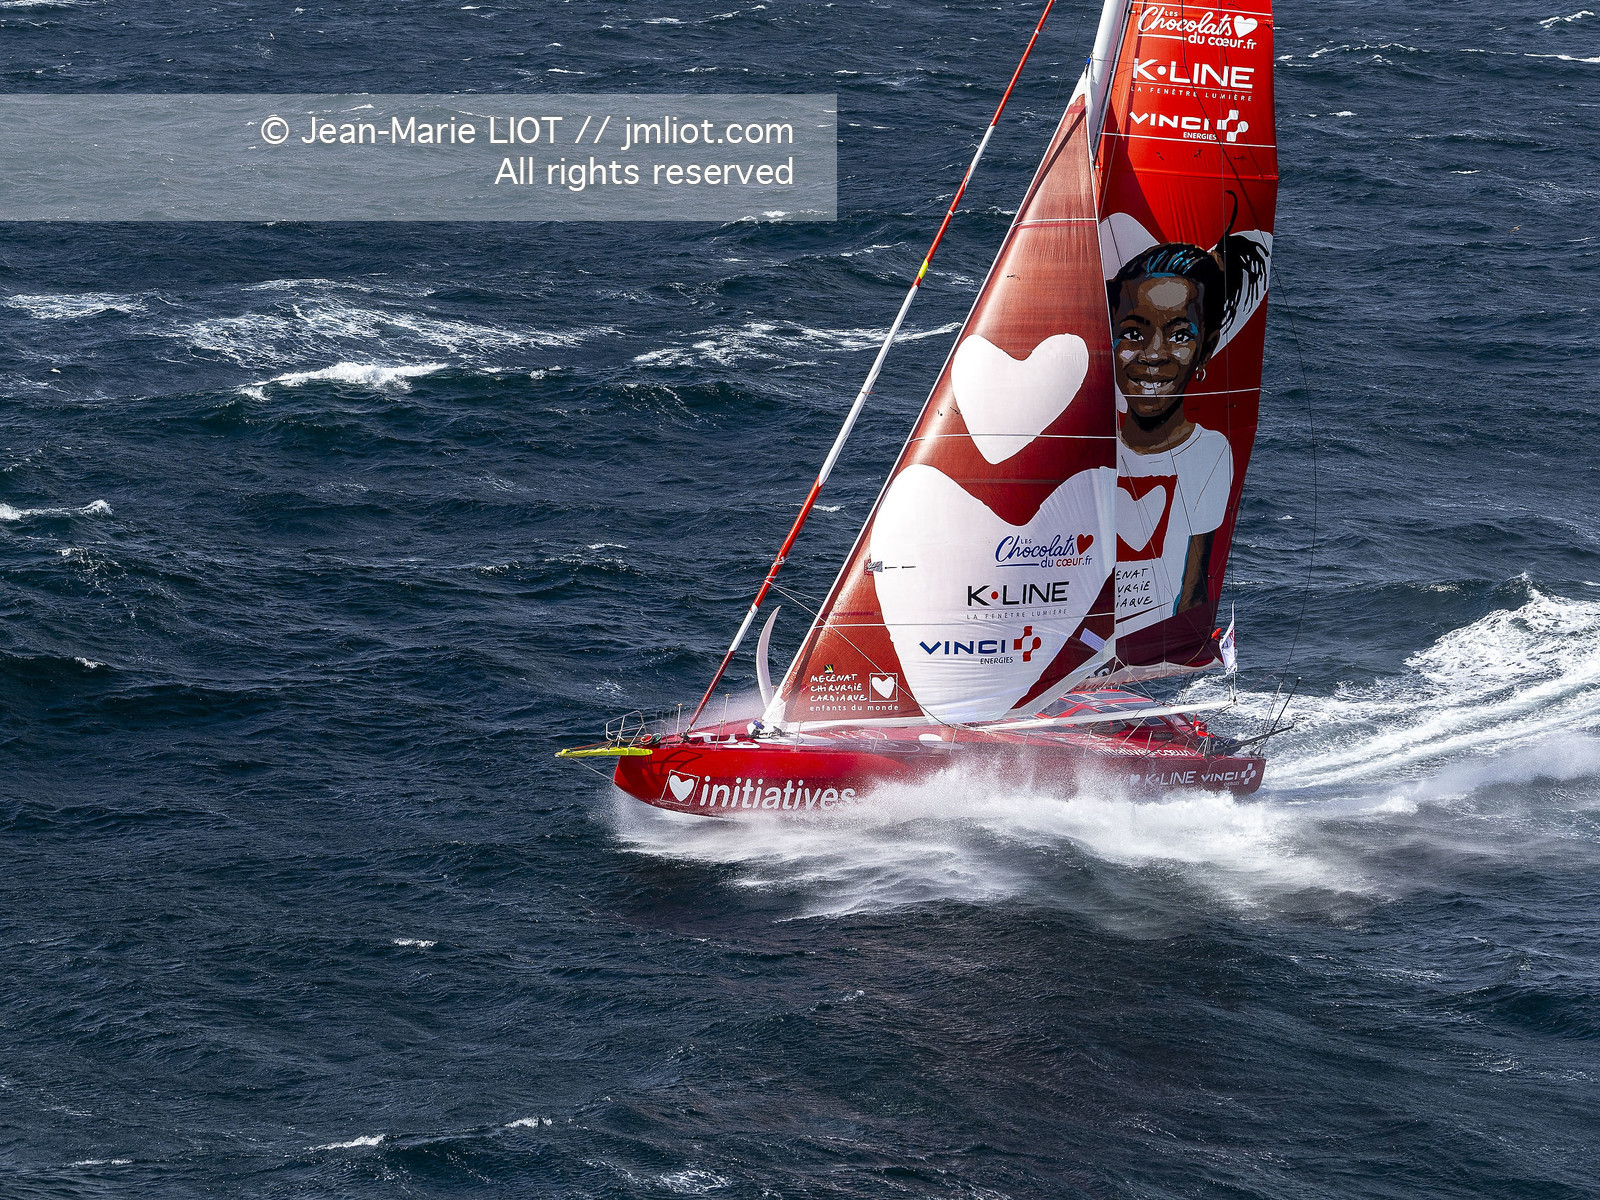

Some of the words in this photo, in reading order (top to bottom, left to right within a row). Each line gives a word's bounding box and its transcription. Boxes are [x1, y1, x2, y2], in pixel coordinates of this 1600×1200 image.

[1137, 6, 1232, 37] Chocolats
[1188, 32, 1206, 45] du
[1150, 87, 1198, 98] FENÊTRE
[1205, 92, 1252, 101] LUMIÈRE
[1129, 111, 1210, 131] VINCI
[1182, 131, 1218, 141] ENERGIES
[994, 534, 1076, 563] Chocolats
[1040, 556, 1054, 569] du
[919, 640, 1006, 655] VINCI
[980, 656, 1014, 665] ENERGIES
[809, 704, 847, 712] enfants
[1200, 771, 1239, 782] VINCI
[699, 775, 856, 811] initiatives
